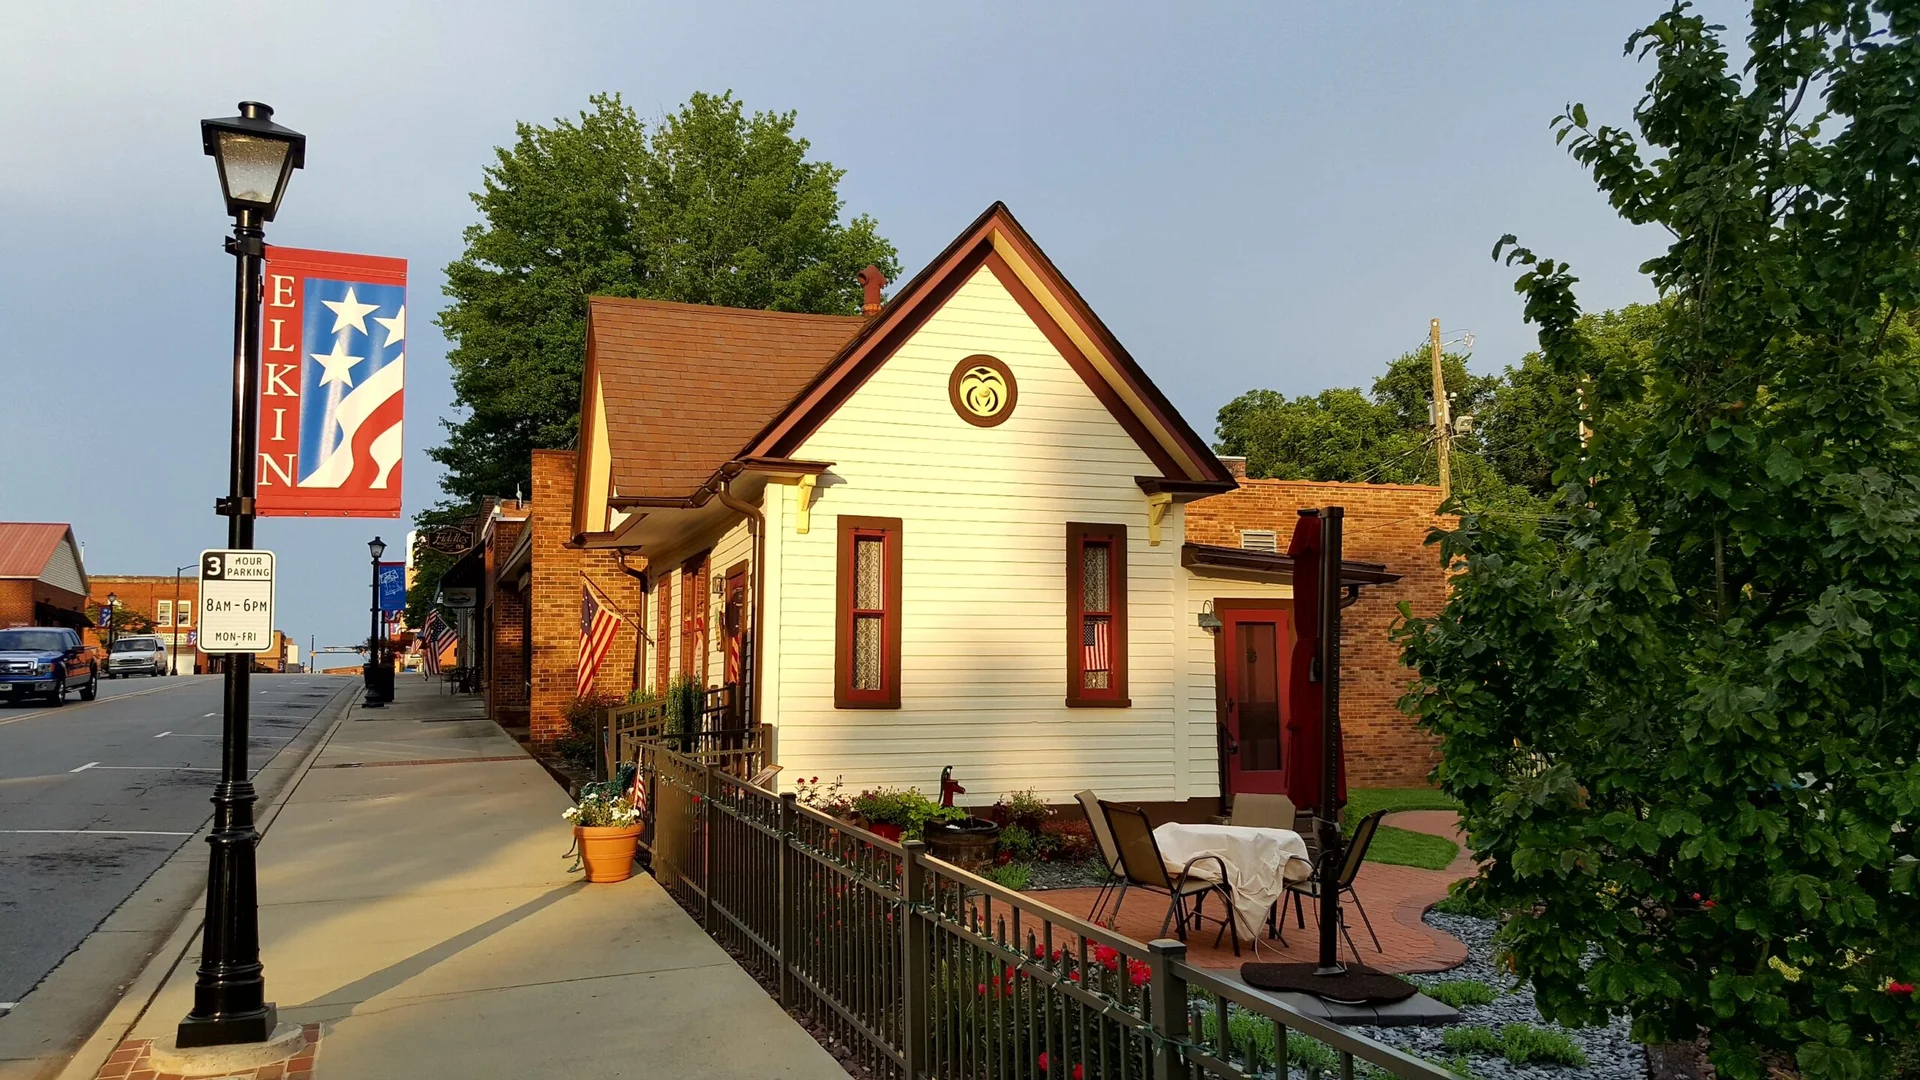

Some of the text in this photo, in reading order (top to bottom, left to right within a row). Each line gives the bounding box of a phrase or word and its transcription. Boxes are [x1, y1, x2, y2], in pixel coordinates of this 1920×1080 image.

[257, 274, 299, 488] ELKIN
[207, 557, 262, 576] 3 HOUR
[227, 568, 270, 576] PARKING
[215, 632, 256, 641] MON-FRI
